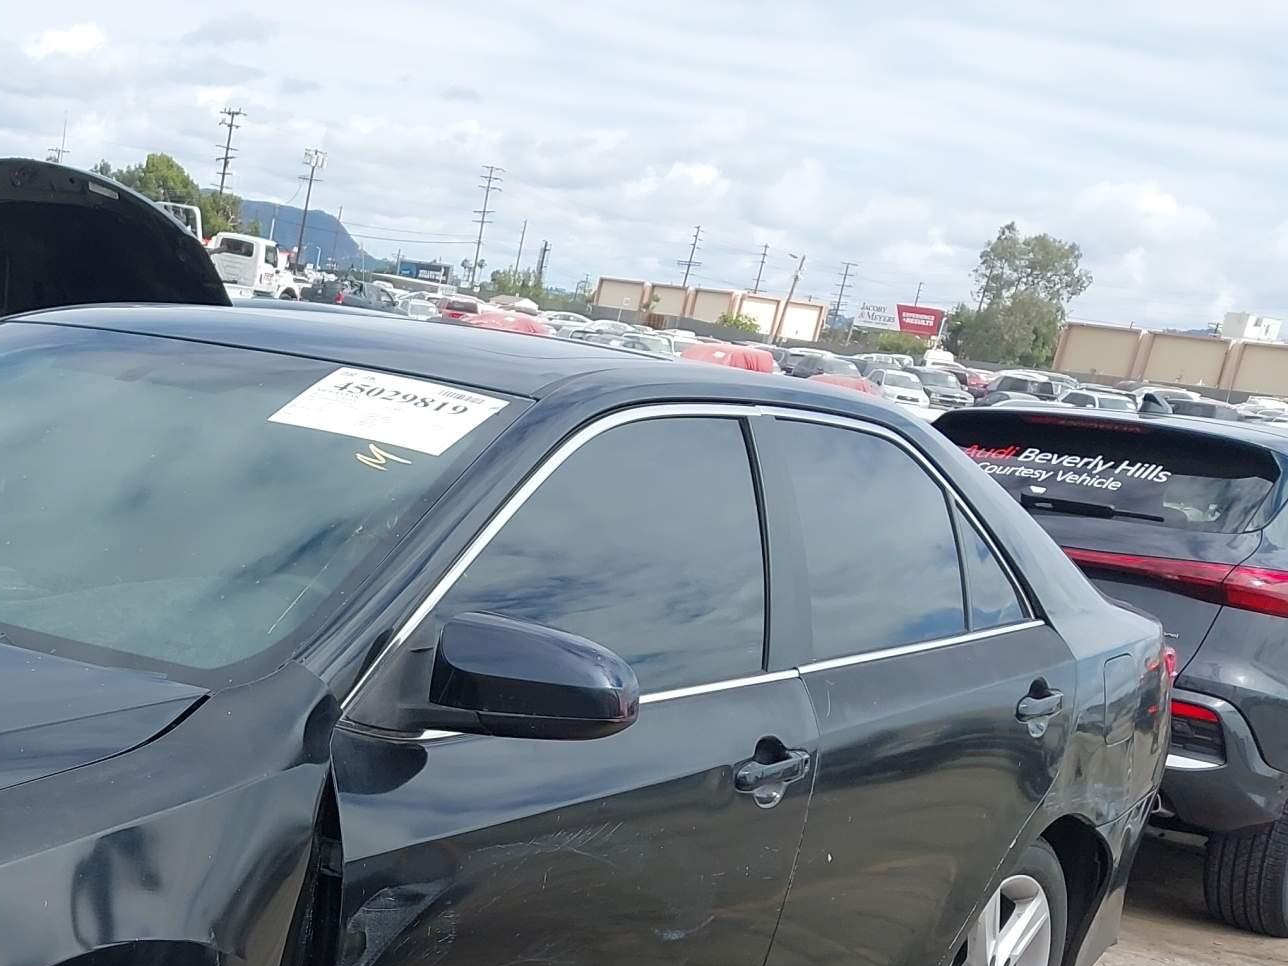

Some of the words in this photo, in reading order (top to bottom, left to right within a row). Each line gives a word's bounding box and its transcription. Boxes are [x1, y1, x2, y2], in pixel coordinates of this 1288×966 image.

[333, 381, 468, 415] 45029819
[964, 444, 1020, 459] Audi
[1018, 447, 1114, 474] Beverly
[1114, 459, 1172, 484] Hills
[977, 461, 1054, 482] Courtesy
[1056, 470, 1123, 492] Vehicle
